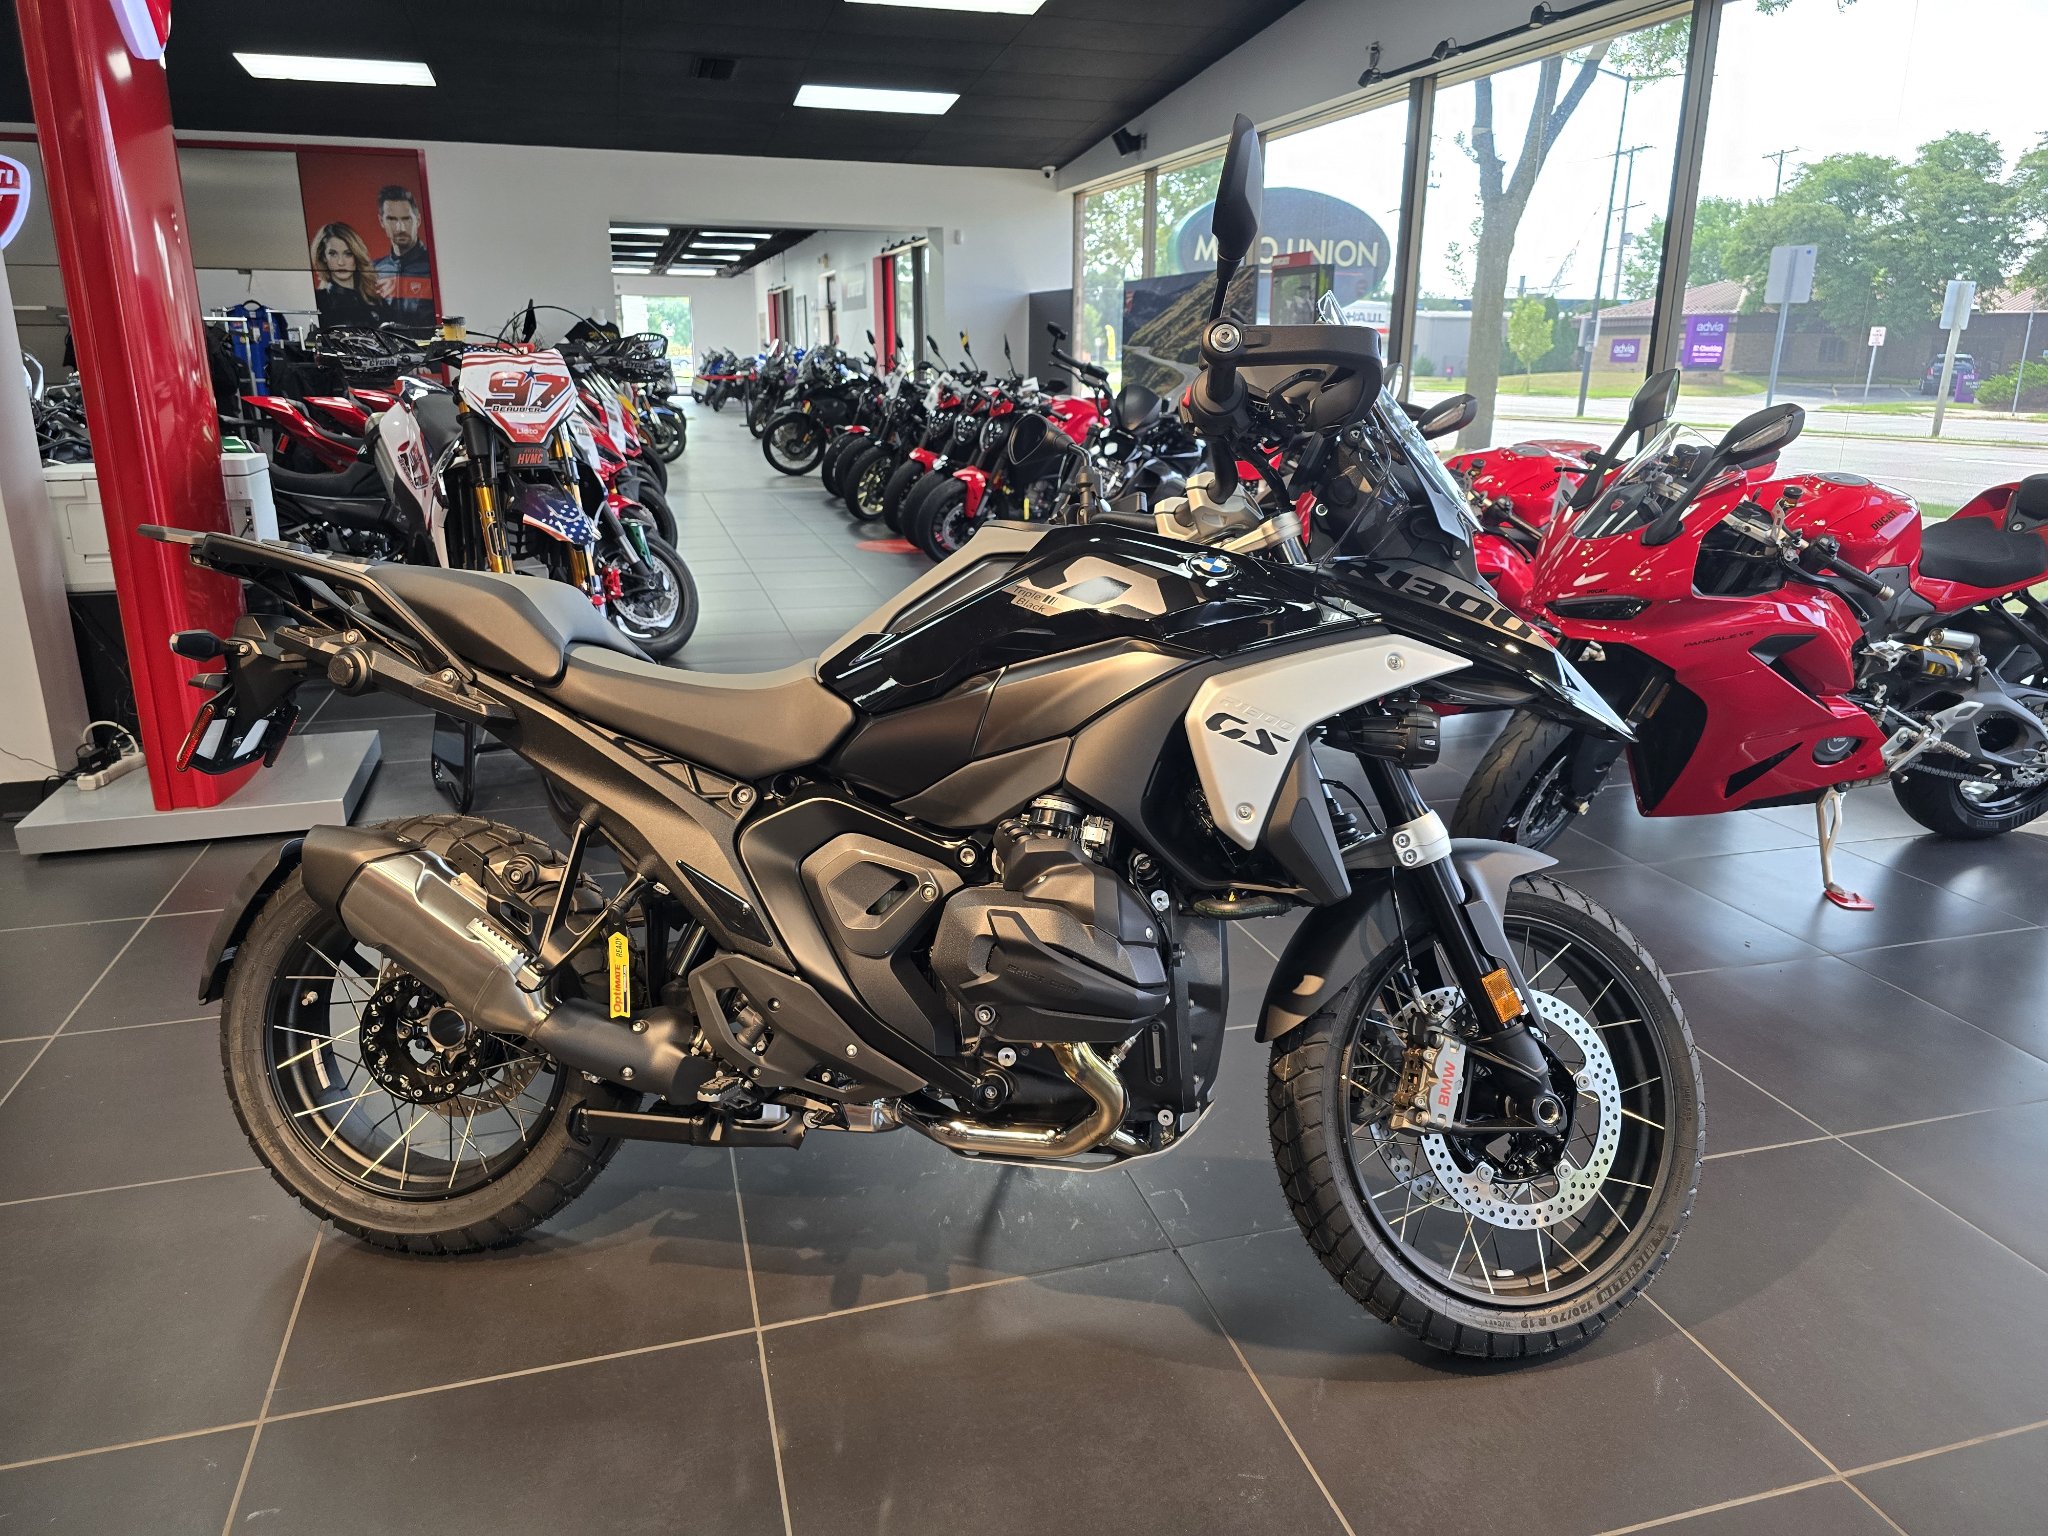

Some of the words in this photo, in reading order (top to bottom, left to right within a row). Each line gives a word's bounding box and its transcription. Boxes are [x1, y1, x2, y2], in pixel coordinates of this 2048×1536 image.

[1194, 234, 1279, 265] MO
[1286, 237, 1379, 268] UNION
[1696, 321, 1725, 332] advia
[484, 371, 571, 409] 97
[517, 453, 544, 465] HVMC
[1539, 475, 1562, 492] DUCA
[1870, 509, 1899, 531] DUCATI
[1013, 585, 1042, 601] Triple
[1340, 559, 1532, 640] R1300
[1016, 597, 1046, 613] Black
[1684, 634, 1737, 648] PANIGALE
[1205, 712, 1291, 756] GS
[615, 936, 623, 958] READY
[613, 963, 623, 1013] OptiMATE
[1437, 1059, 1456, 1108] BMW
[1600, 1241, 1657, 1304] MICHELIN
[1520, 1319, 1535, 1329] 19
[1538, 1318, 1547, 1327] R
[1550, 1303, 1594, 1326] 120/70
